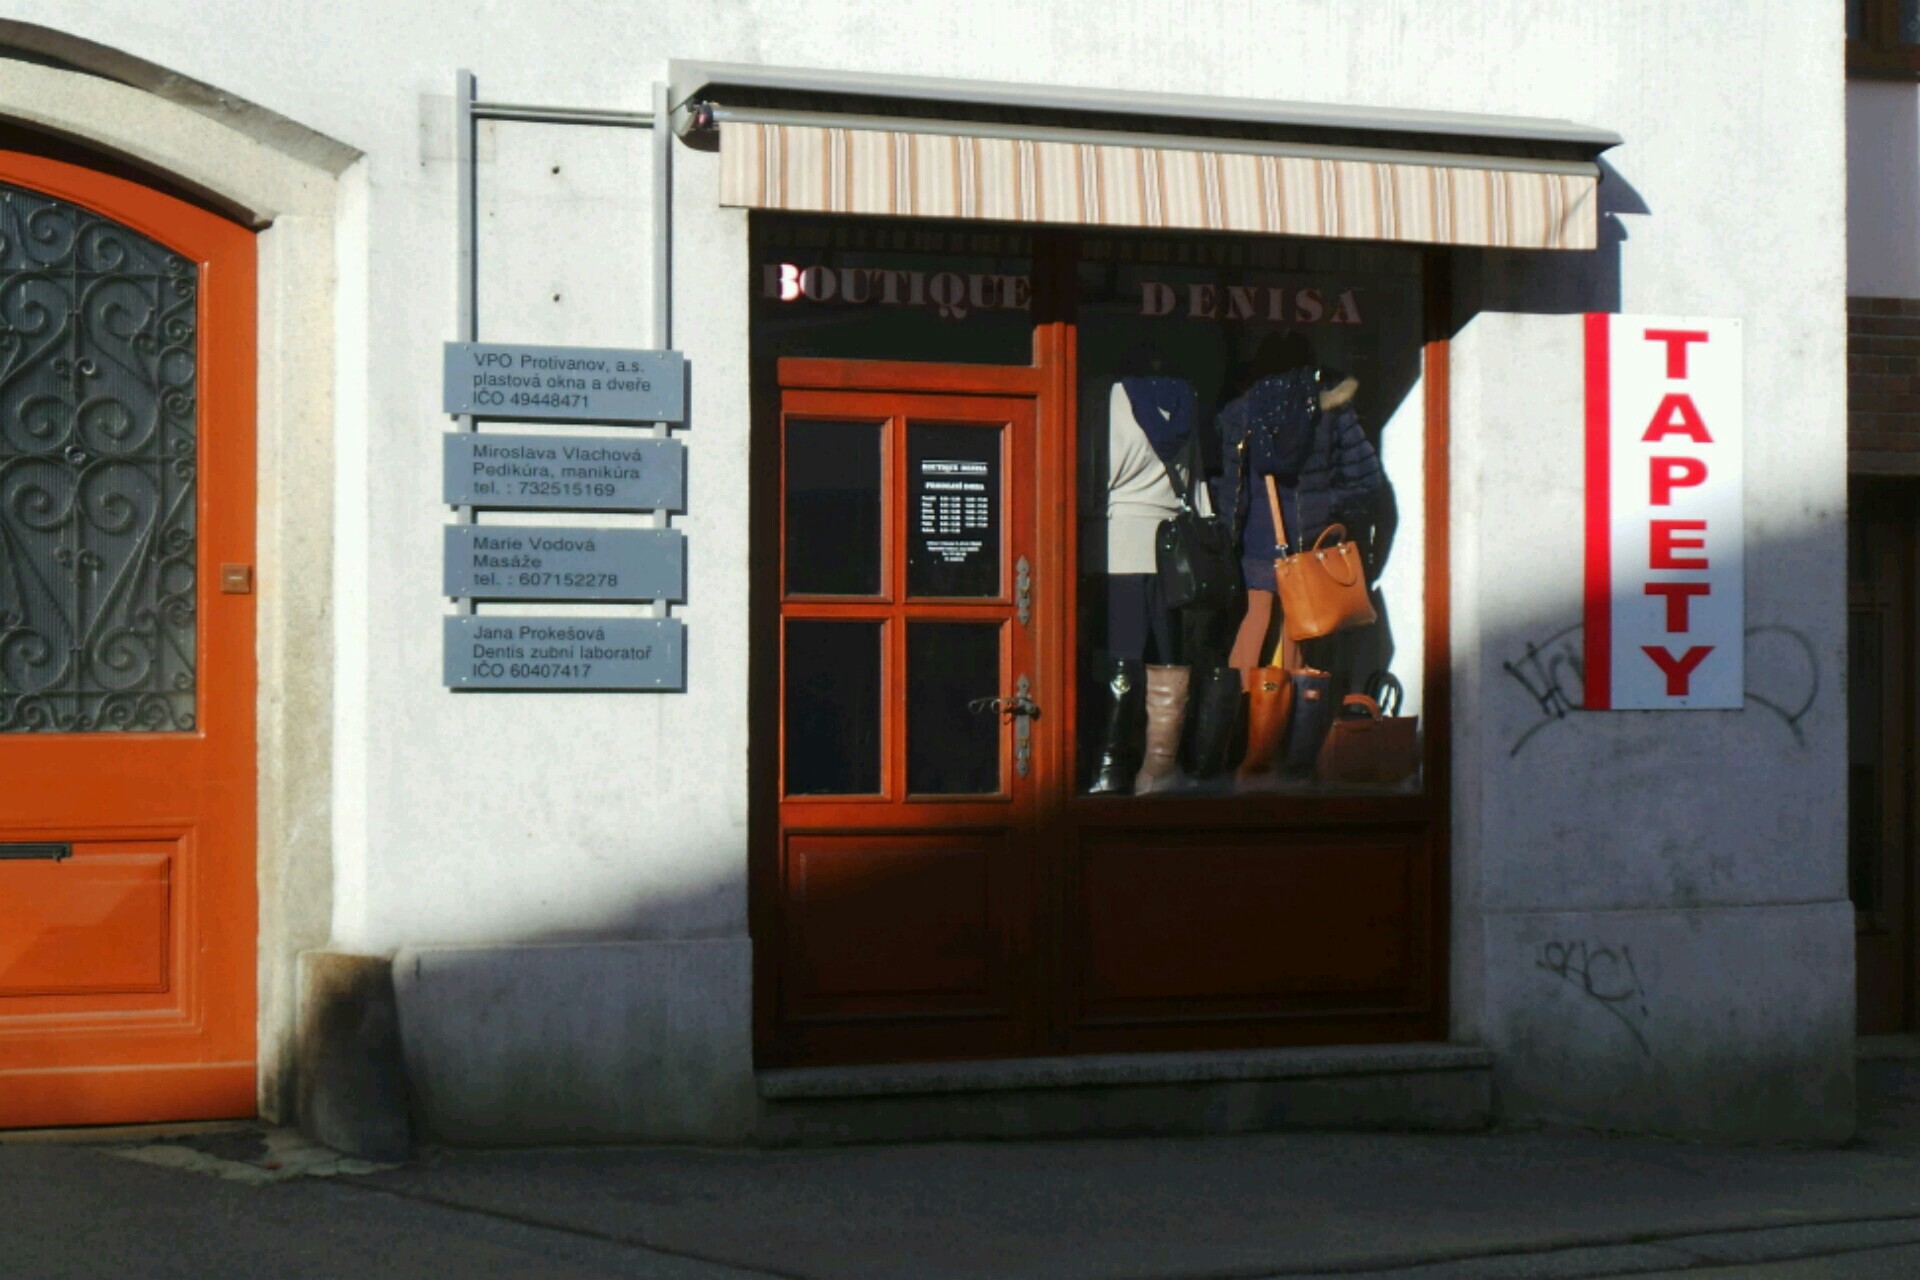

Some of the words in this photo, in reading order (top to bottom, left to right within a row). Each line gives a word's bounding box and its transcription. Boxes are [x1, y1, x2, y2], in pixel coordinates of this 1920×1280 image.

[763, 263, 1032, 319] BOUTIQUE
[1140, 281, 1364, 325] DENISA
[473, 353, 513, 368] VPO
[520, 355, 610, 374] Protivanov,
[615, 361, 645, 373] a.s.
[473, 372, 541, 391] plastová
[546, 376, 586, 390] okna
[591, 380, 602, 390] a
[606, 377, 652, 393] dveře
[509, 392, 589, 408] 49448471
[473, 445, 557, 460] Miroslava
[562, 446, 643, 463] Vlachová
[473, 462, 554, 479] Pedikúra,
[561, 463, 641, 480] manikúra
[519, 482, 616, 497] 732515169
[1641, 328, 1716, 696] TAPETY
[473, 536, 522, 551] Marie
[529, 537, 596, 552] Vodová
[473, 554, 543, 569] Masáže
[518, 572, 619, 588] 607152278
[473, 626, 514, 640] Jana
[518, 626, 606, 642] Prokešová
[473, 644, 525, 659] Dentis
[529, 645, 575, 660] zubní
[579, 645, 653, 662] laboratoř
[509, 664, 592, 680] 60407417
